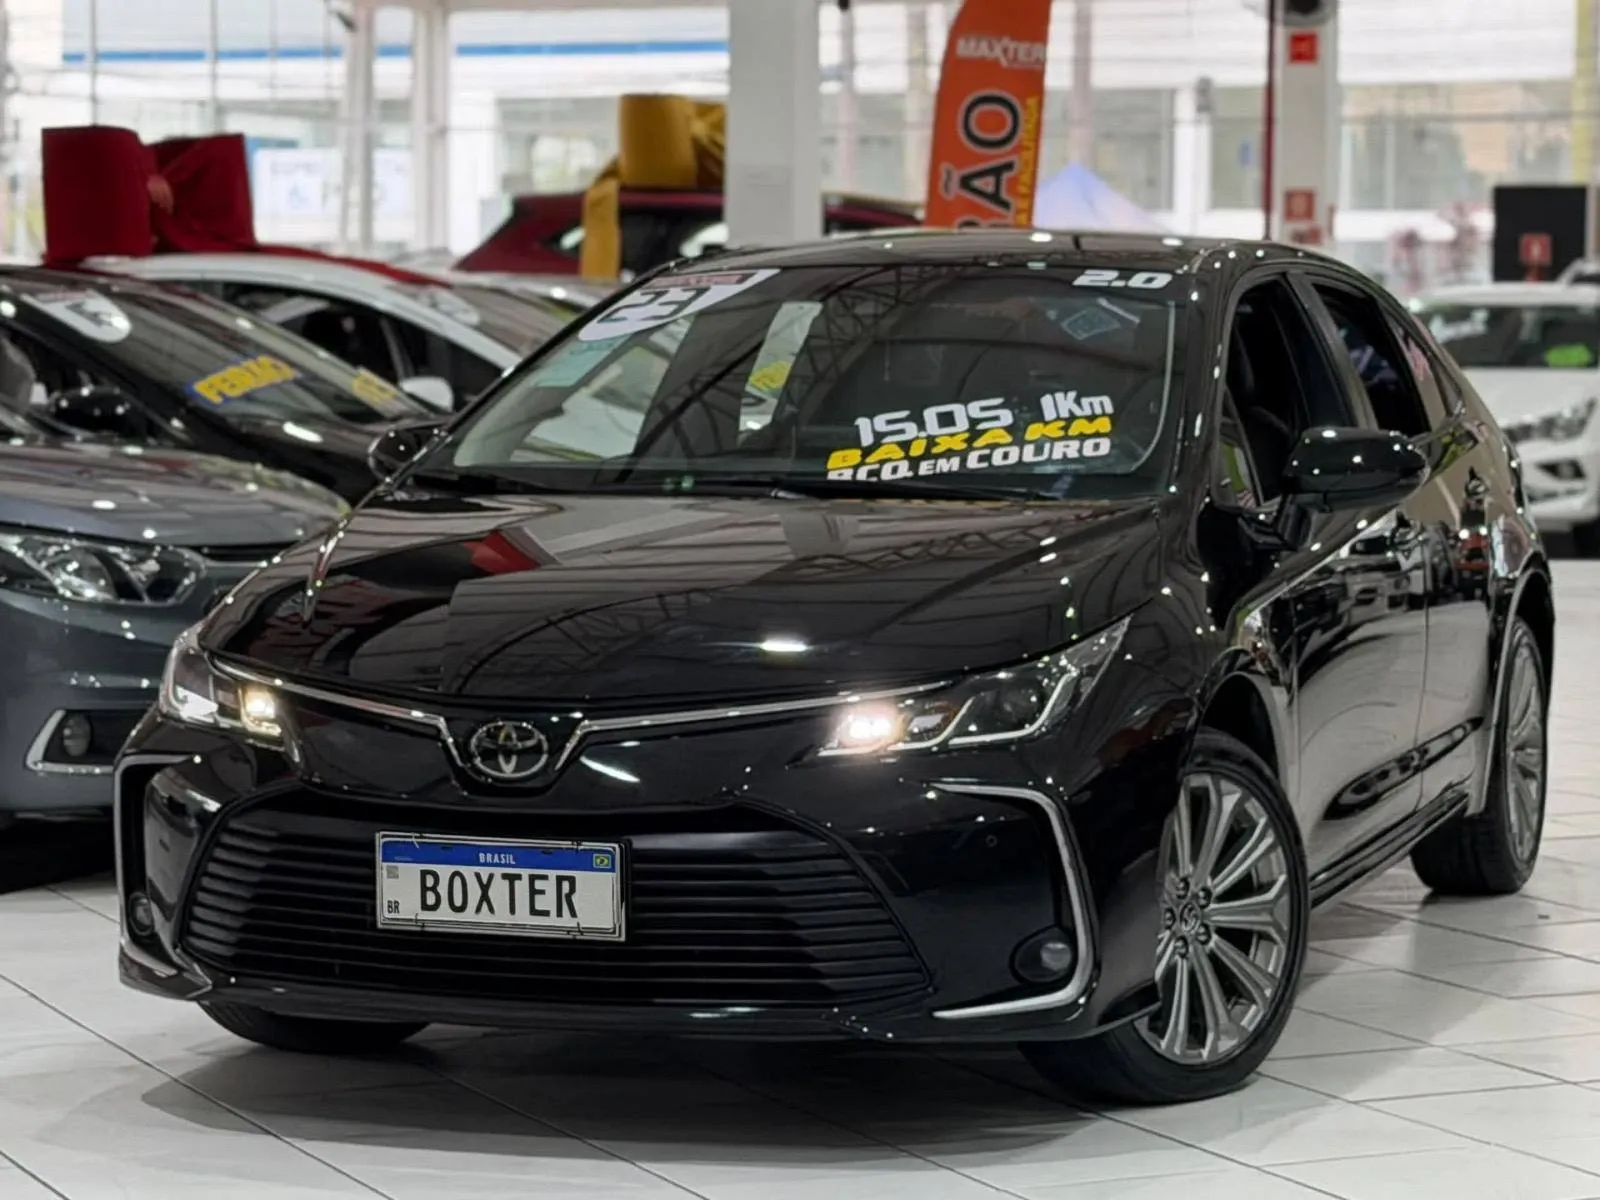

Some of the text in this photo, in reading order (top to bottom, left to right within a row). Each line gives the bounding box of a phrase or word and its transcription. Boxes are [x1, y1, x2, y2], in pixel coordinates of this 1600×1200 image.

[1072, 269, 1173, 289] 2.0
[596, 286, 712, 325] 23
[1040, 390, 1114, 422] 1Km
[826, 416, 1112, 470] BAIXA KM
[918, 458, 959, 477] EM
[966, 437, 1111, 470] COURO
[479, 852, 516, 865] BRASIL
[387, 900, 400, 914] BR
[420, 869, 578, 918] BOXTER
